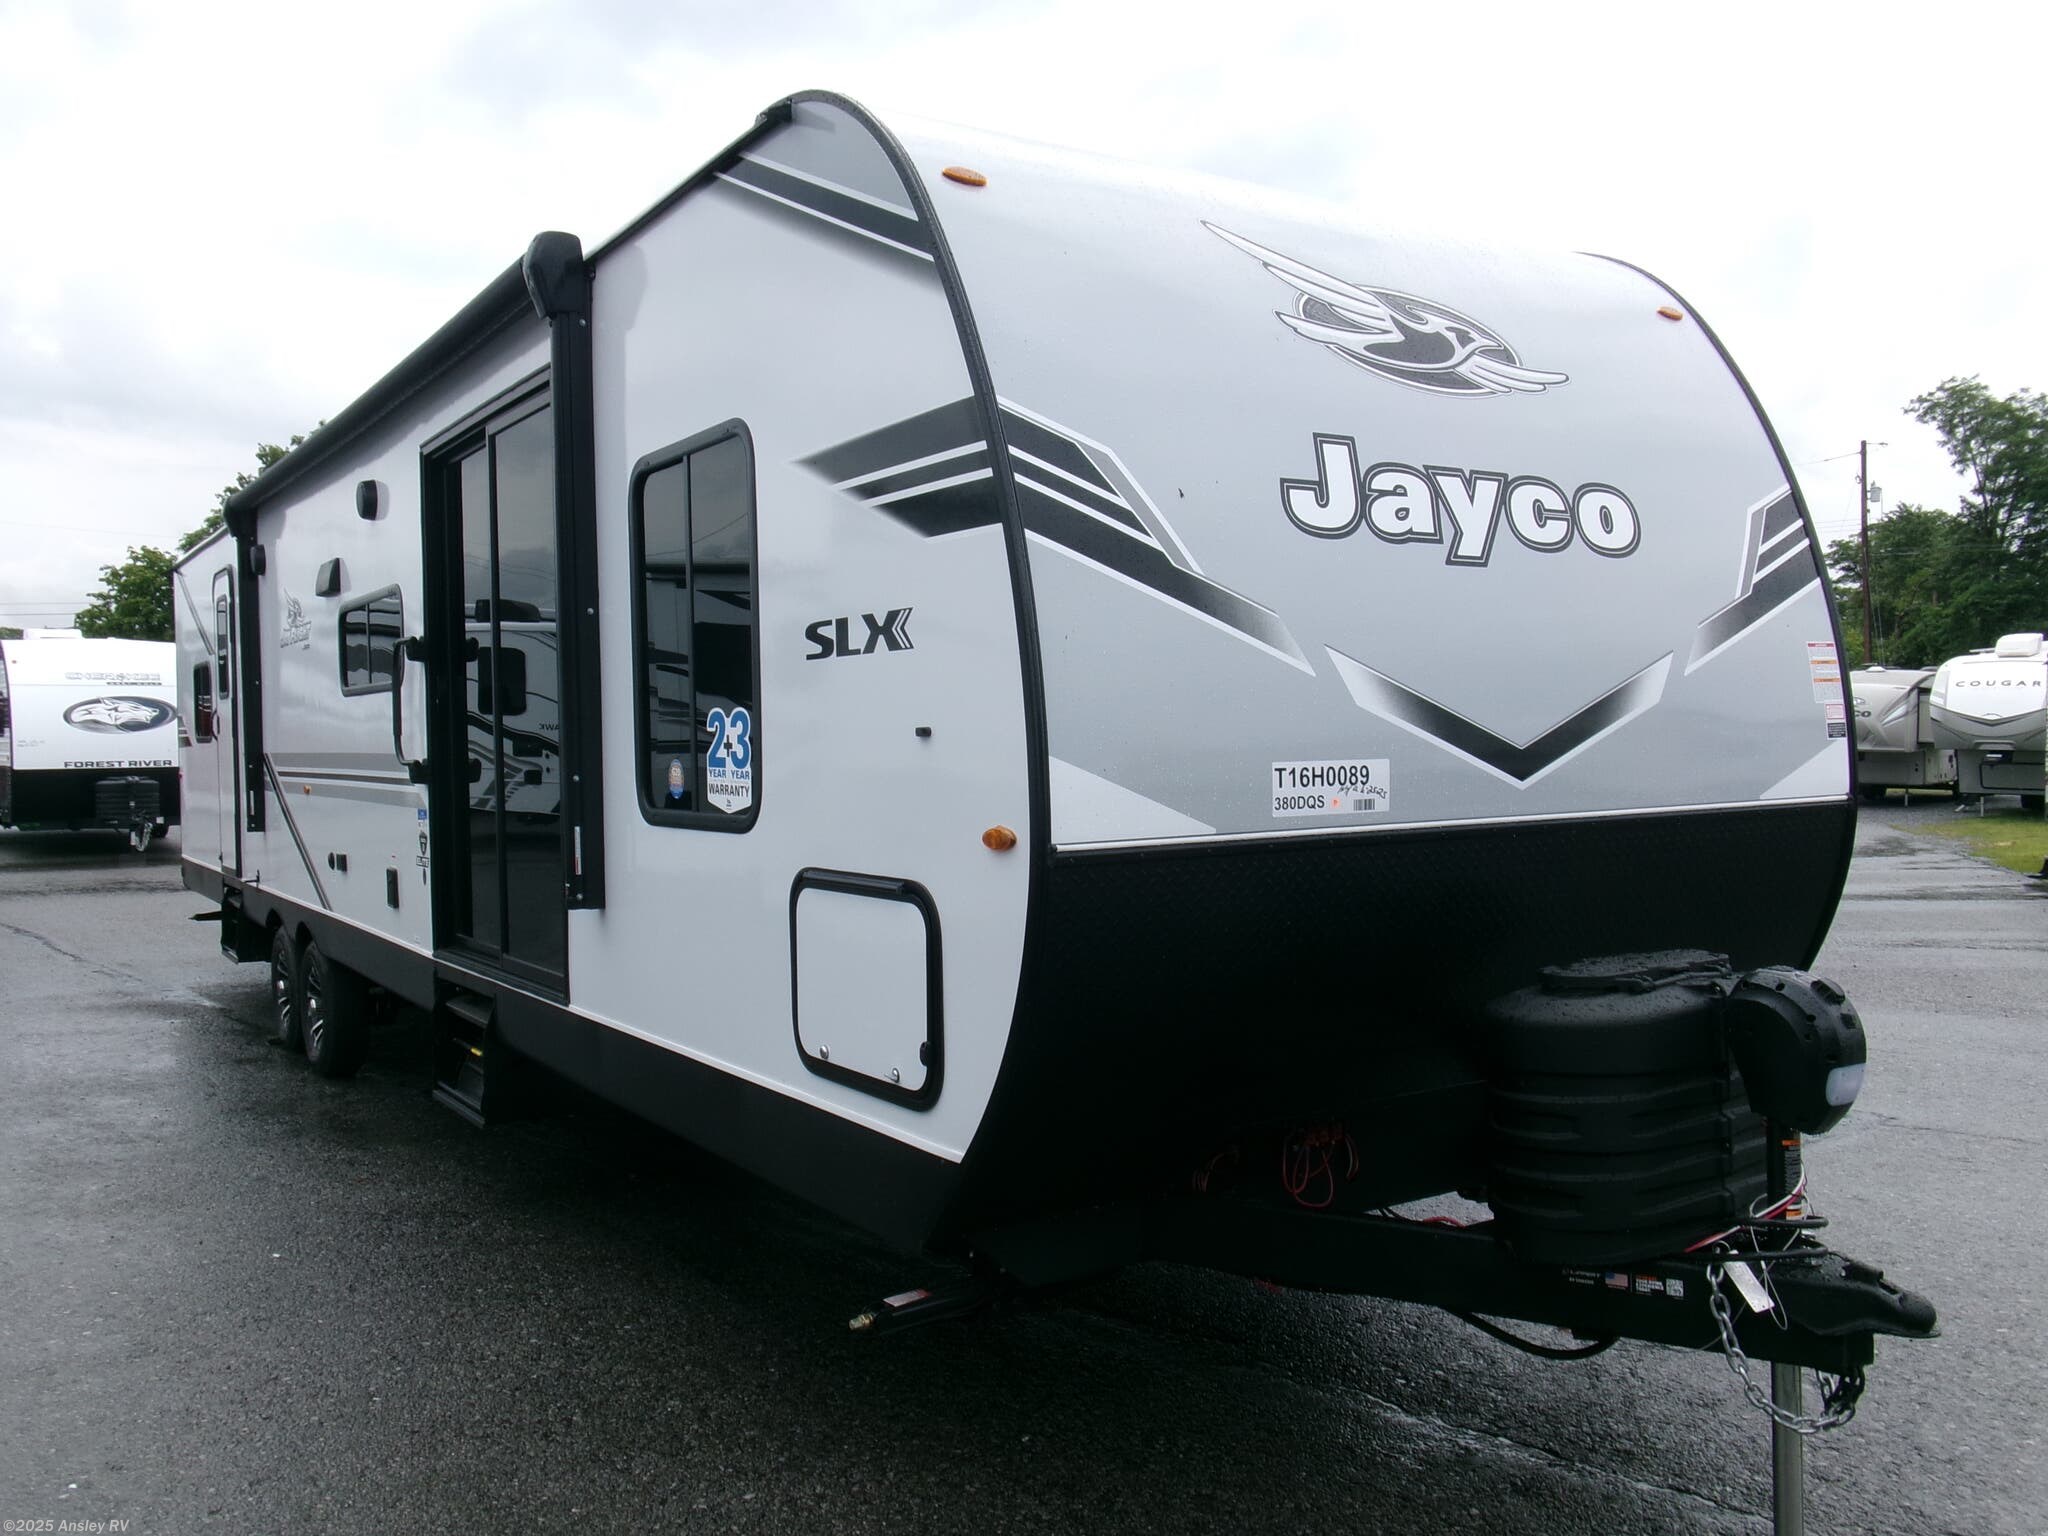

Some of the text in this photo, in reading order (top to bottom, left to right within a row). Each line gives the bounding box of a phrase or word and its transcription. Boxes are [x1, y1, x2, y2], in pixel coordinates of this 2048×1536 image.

[1280, 432, 1641, 568] Jayco
[805, 607, 914, 660] SLX
[1955, 680, 2042, 688] COUGAR
[64, 759, 173, 768] FOREST RIVER
[709, 768, 750, 780] YEAR YEAR
[1274, 765, 1370, 788] T16H0089
[709, 783, 749, 797] WARRANTY
[1274, 795, 1325, 811] 380DQS
